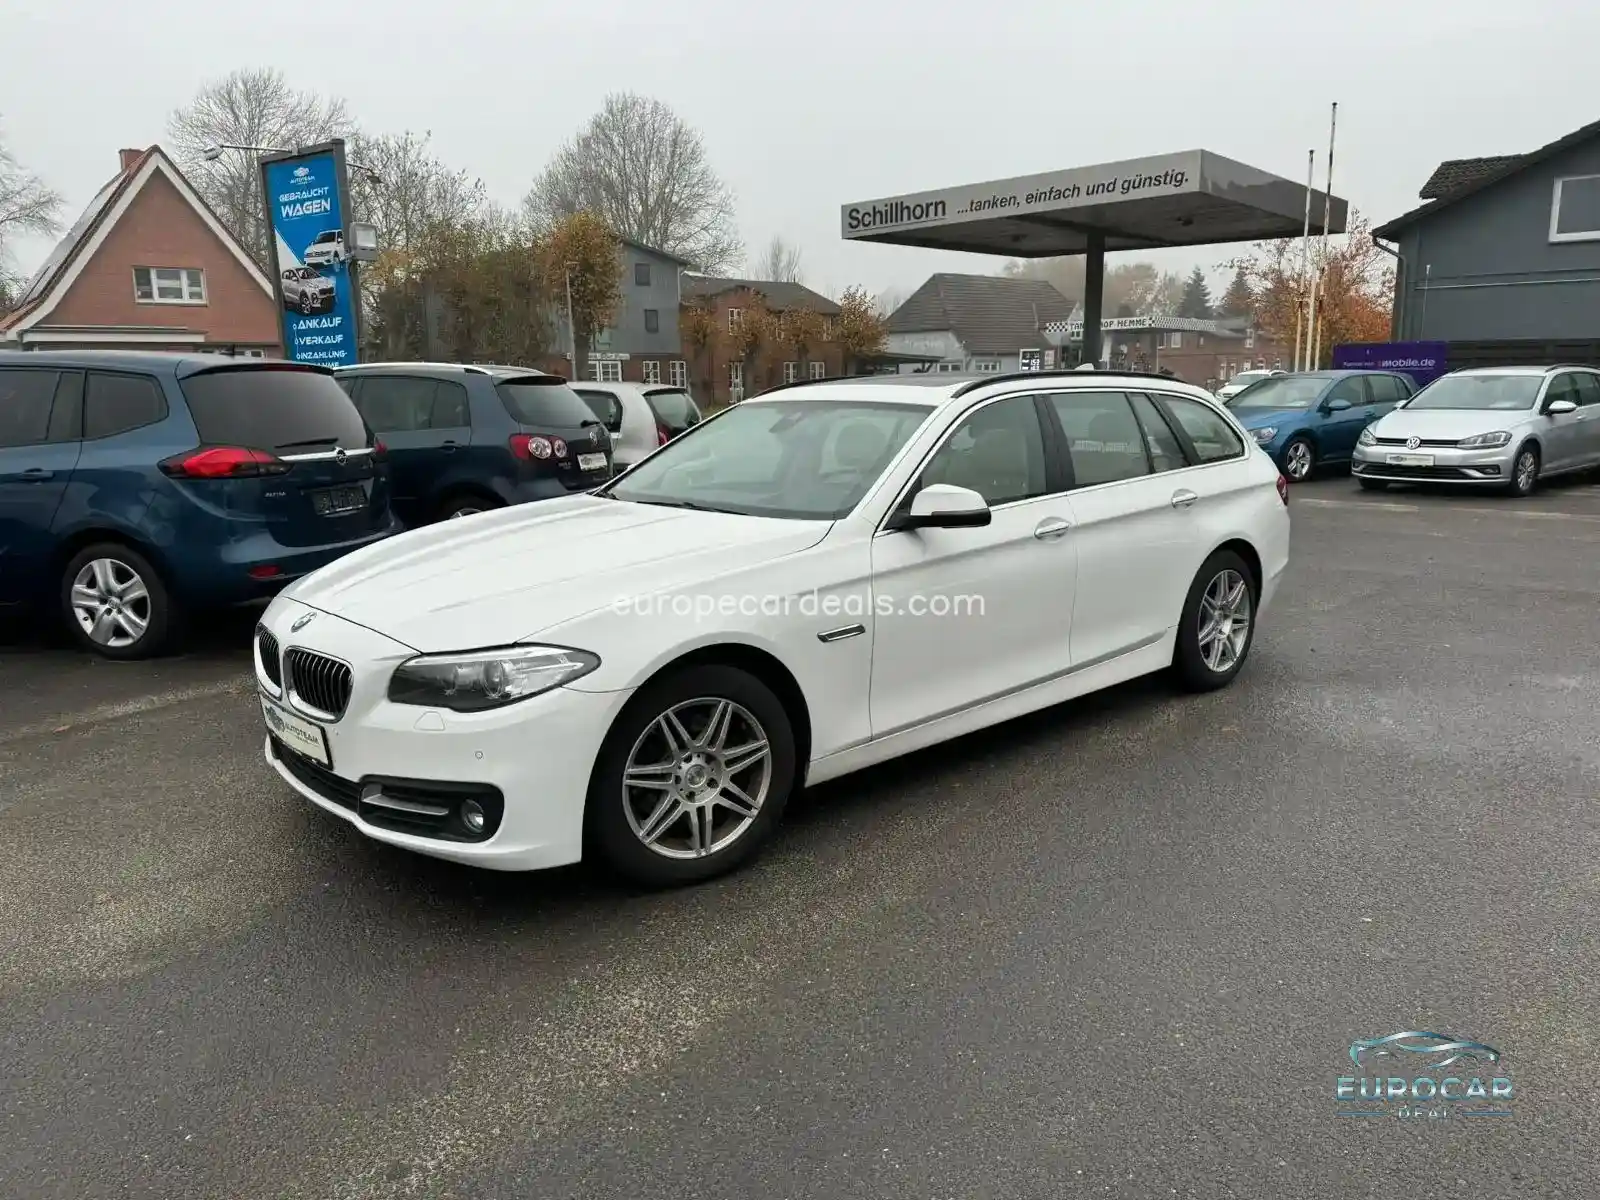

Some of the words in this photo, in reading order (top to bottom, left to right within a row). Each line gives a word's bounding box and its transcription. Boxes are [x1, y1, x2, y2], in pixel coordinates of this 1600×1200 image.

[278, 186, 329, 202] GEBRAUCHT
[847, 199, 947, 229] Schillhorn
[957, 192, 1020, 214] ...tanken,
[1025, 184, 1081, 204] einfach
[1085, 178, 1117, 196] und
[1119, 169, 1189, 194] günstig.
[281, 197, 331, 218] WAGEN
[297, 316, 342, 330] ANKAUF
[1116, 318, 1147, 328] HEMME
[299, 334, 344, 345] VERKAUF
